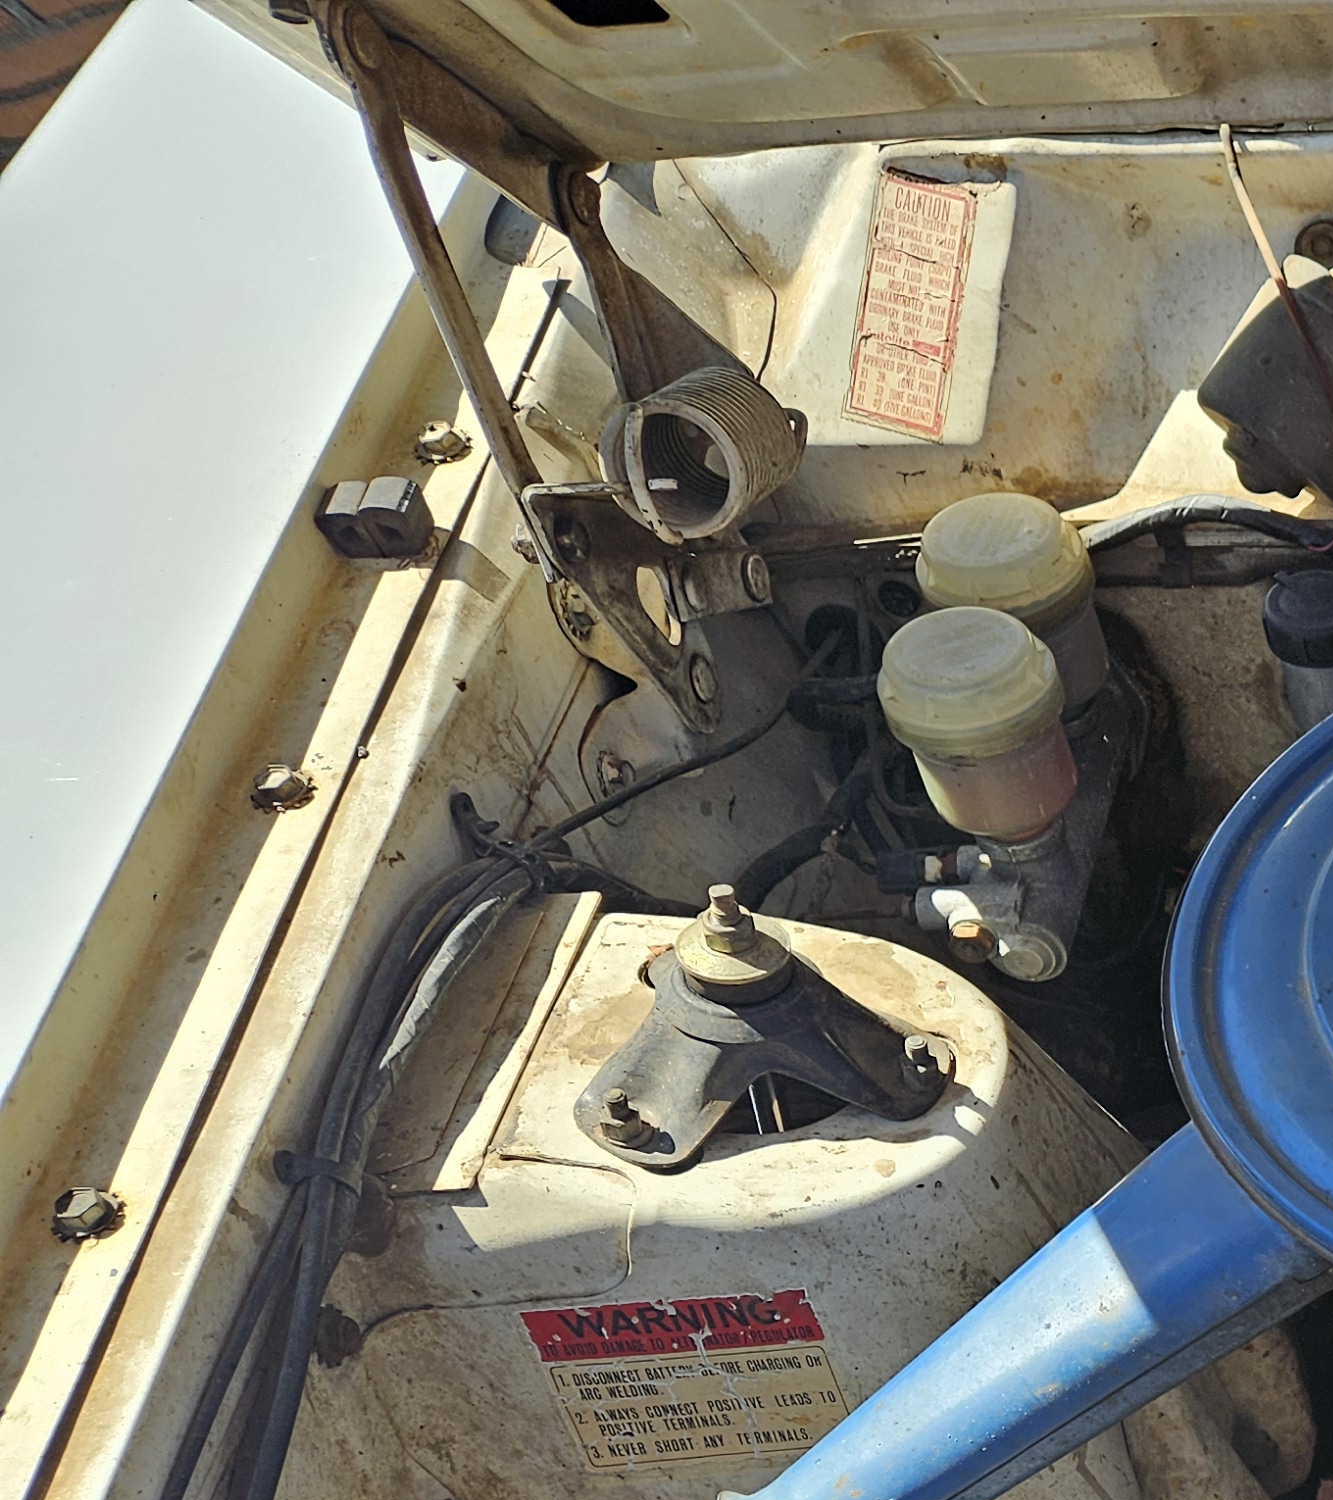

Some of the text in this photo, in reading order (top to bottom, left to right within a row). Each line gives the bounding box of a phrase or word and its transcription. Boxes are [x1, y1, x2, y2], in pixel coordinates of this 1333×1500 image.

[894, 186, 951, 222] CAUTION
[881, 221, 896, 236] THIS
[897, 226, 923, 243] VEHICLE
[898, 211, 919, 228] BRAKE
[921, 219, 948, 235] SYSTEM
[949, 225, 959, 237] OF
[874, 262, 950, 292] BRAKE FLUID WHICH
[888, 278, 906, 293] MUST
[868, 301, 945, 333] ORDINARY BRAKE FLUID
[870, 288, 925, 313] CONTAMINATED
[929, 303, 947, 319] WITH
[887, 321, 921, 340] USE ONLY
[862, 354, 895, 373] APPROVED
[896, 361, 917, 379] BRAKE
[557, 1297, 782, 1339] WARNING
[541, 1337, 666, 1359] TO AVOID DAMAGE TO
[557, 1373, 571, 1387] 1.
[571, 1369, 642, 1387] DISCONNECT
[746, 1355, 802, 1373] CHARGING
[805, 1354, 823, 1368] OR
[579, 1383, 665, 1401] ARC WELDING.
[574, 1390, 837, 1425] 2. ALWAYS CONNECT POSITIVE LEADS TO
[598, 1413, 736, 1437] POSITIVE TERMINALS.
[590, 1427, 813, 1459] 3. NEVER SHORT ANY TERMINALS.
